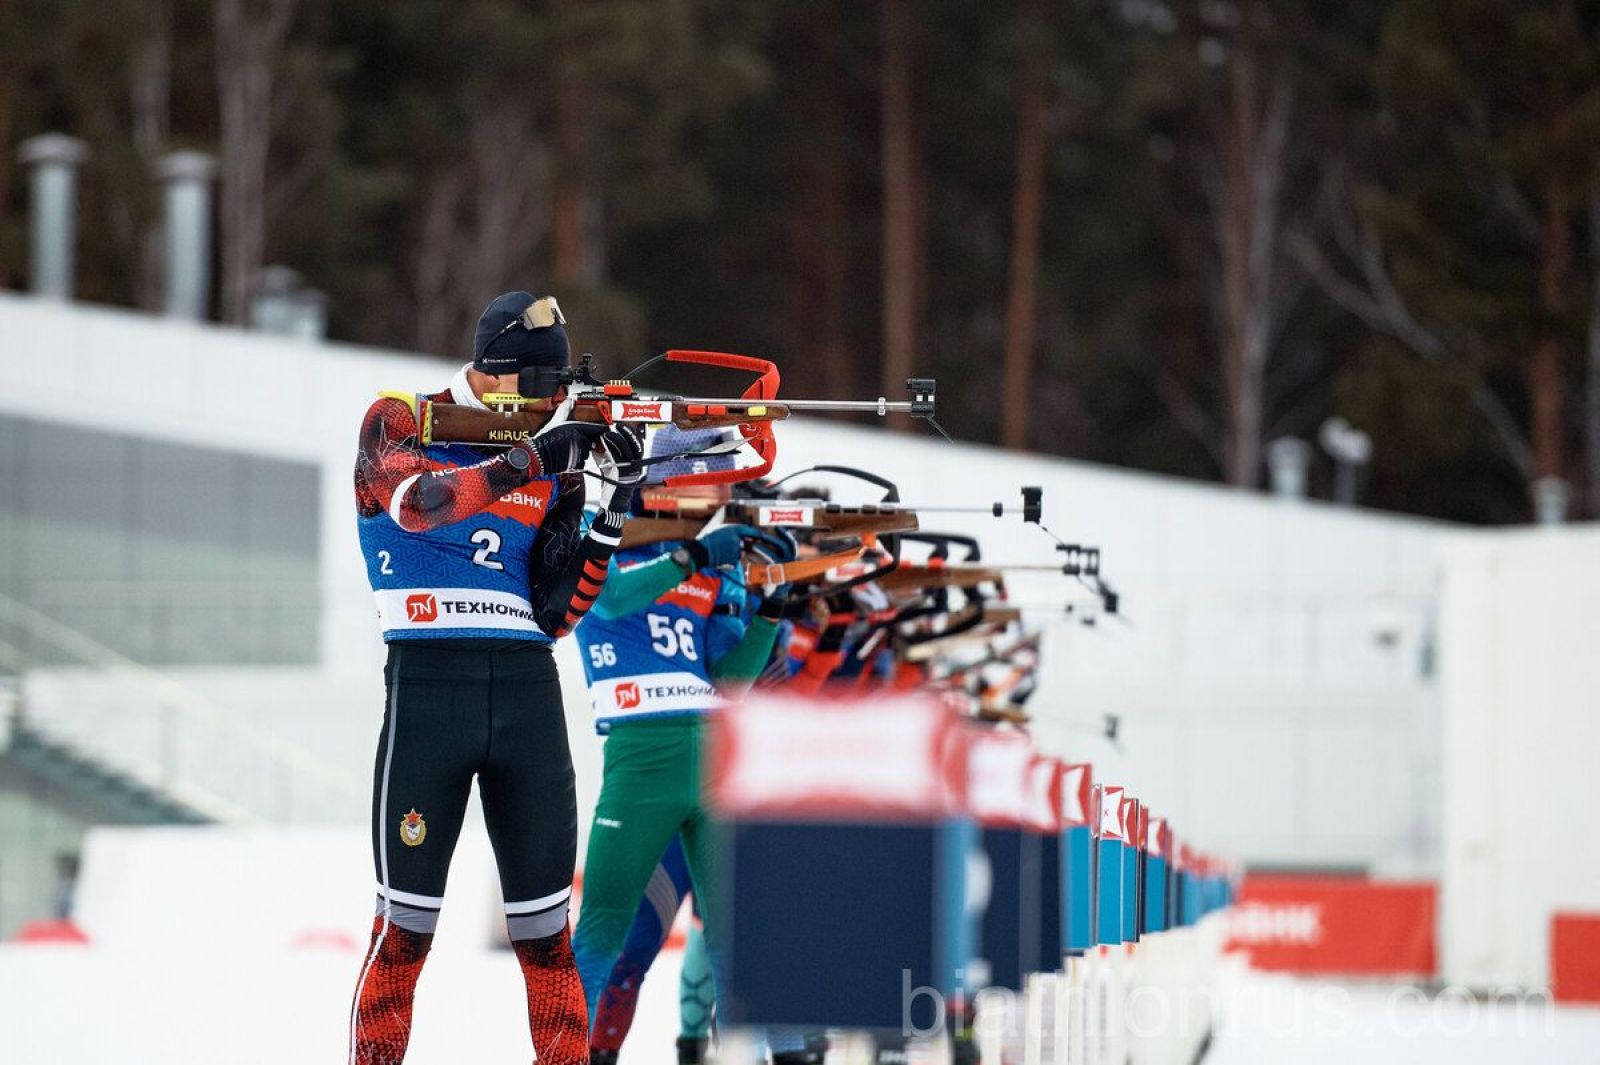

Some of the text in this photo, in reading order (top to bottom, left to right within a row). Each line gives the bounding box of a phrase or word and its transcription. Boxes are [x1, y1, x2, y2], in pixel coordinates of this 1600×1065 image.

[488, 429, 530, 442] KIIRUS
[377, 550, 394, 576] 2
[470, 528, 504, 571] 2
[646, 612, 698, 662] 56
[588, 642, 617, 669] 56
